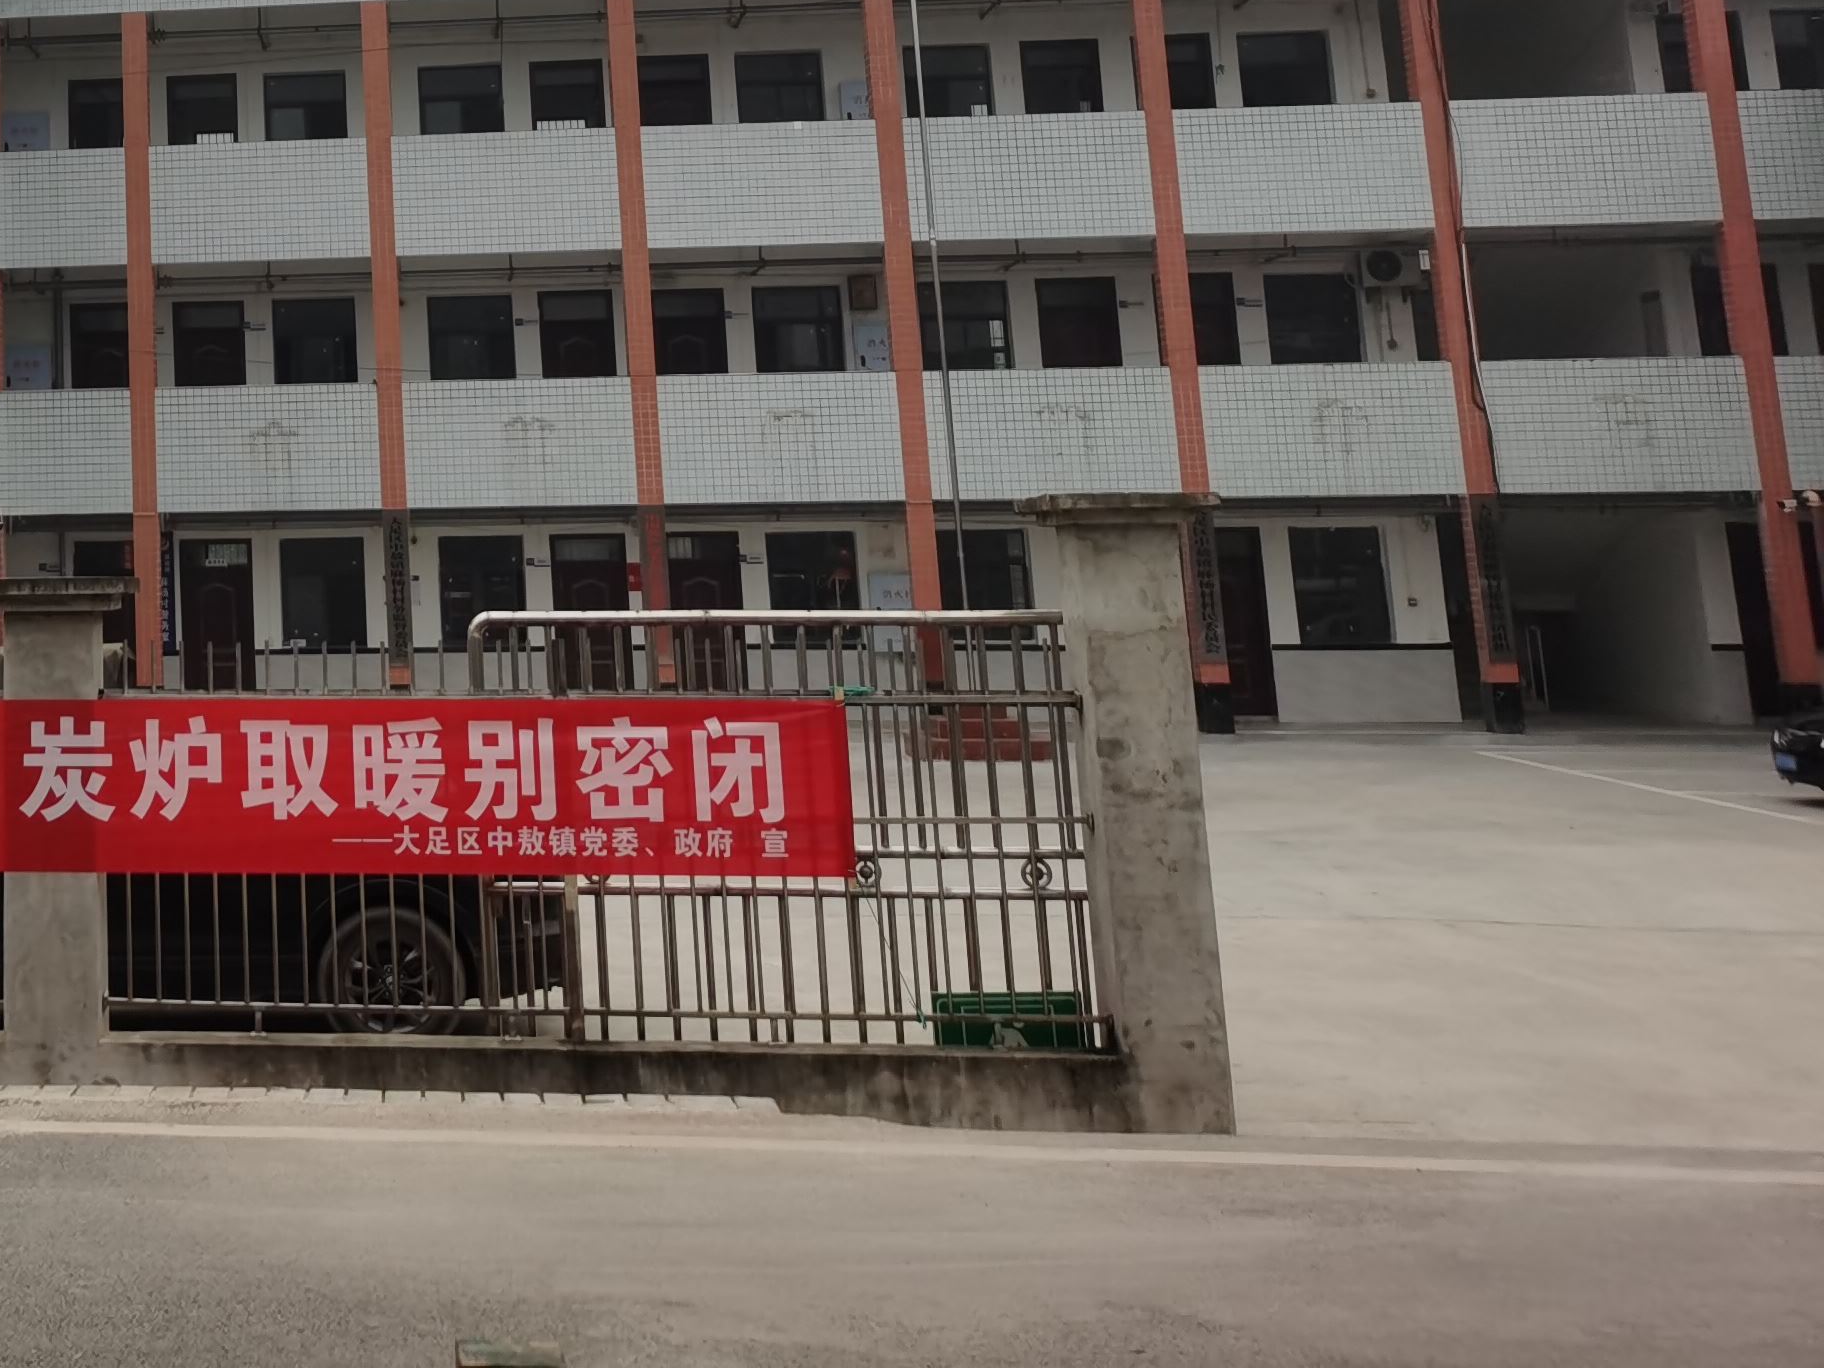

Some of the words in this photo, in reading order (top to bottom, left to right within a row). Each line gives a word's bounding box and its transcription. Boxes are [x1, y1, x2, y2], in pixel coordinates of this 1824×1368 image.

[19, 716, 786, 823] 炭炉取暖别密闭
[760, 829, 789, 858] 宣
